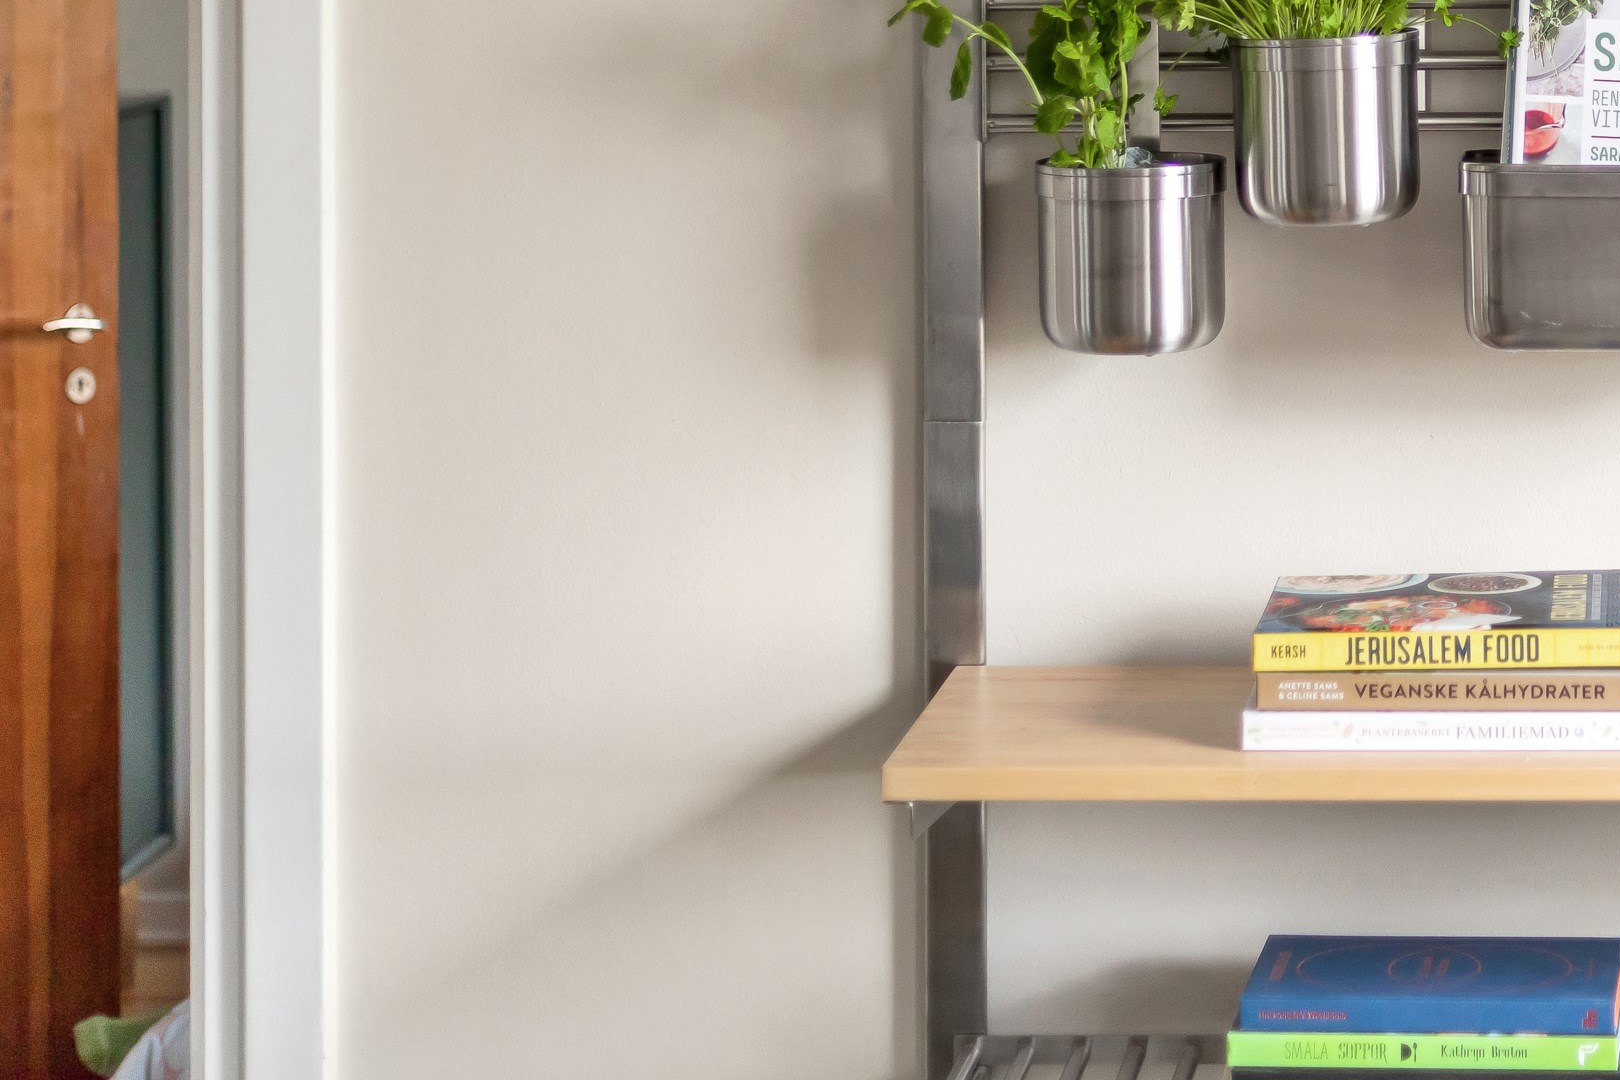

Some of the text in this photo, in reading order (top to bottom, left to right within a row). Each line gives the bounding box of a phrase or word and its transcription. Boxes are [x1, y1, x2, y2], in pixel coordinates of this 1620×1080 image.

[1271, 634, 1540, 666] KERSH JERUSALEM FOOD
[1278, 681, 1338, 690] ANETTE SAMS
[1354, 679, 1606, 700] VEGANSKE KÅLHYDRATER
[1320, 691, 1345, 700] SAMS
[1361, 725, 1570, 740] PLANTEBASERET FAMILIEMAD
[1284, 1041, 1528, 1064] SMALA SOPPOR Kathryn Bruton
